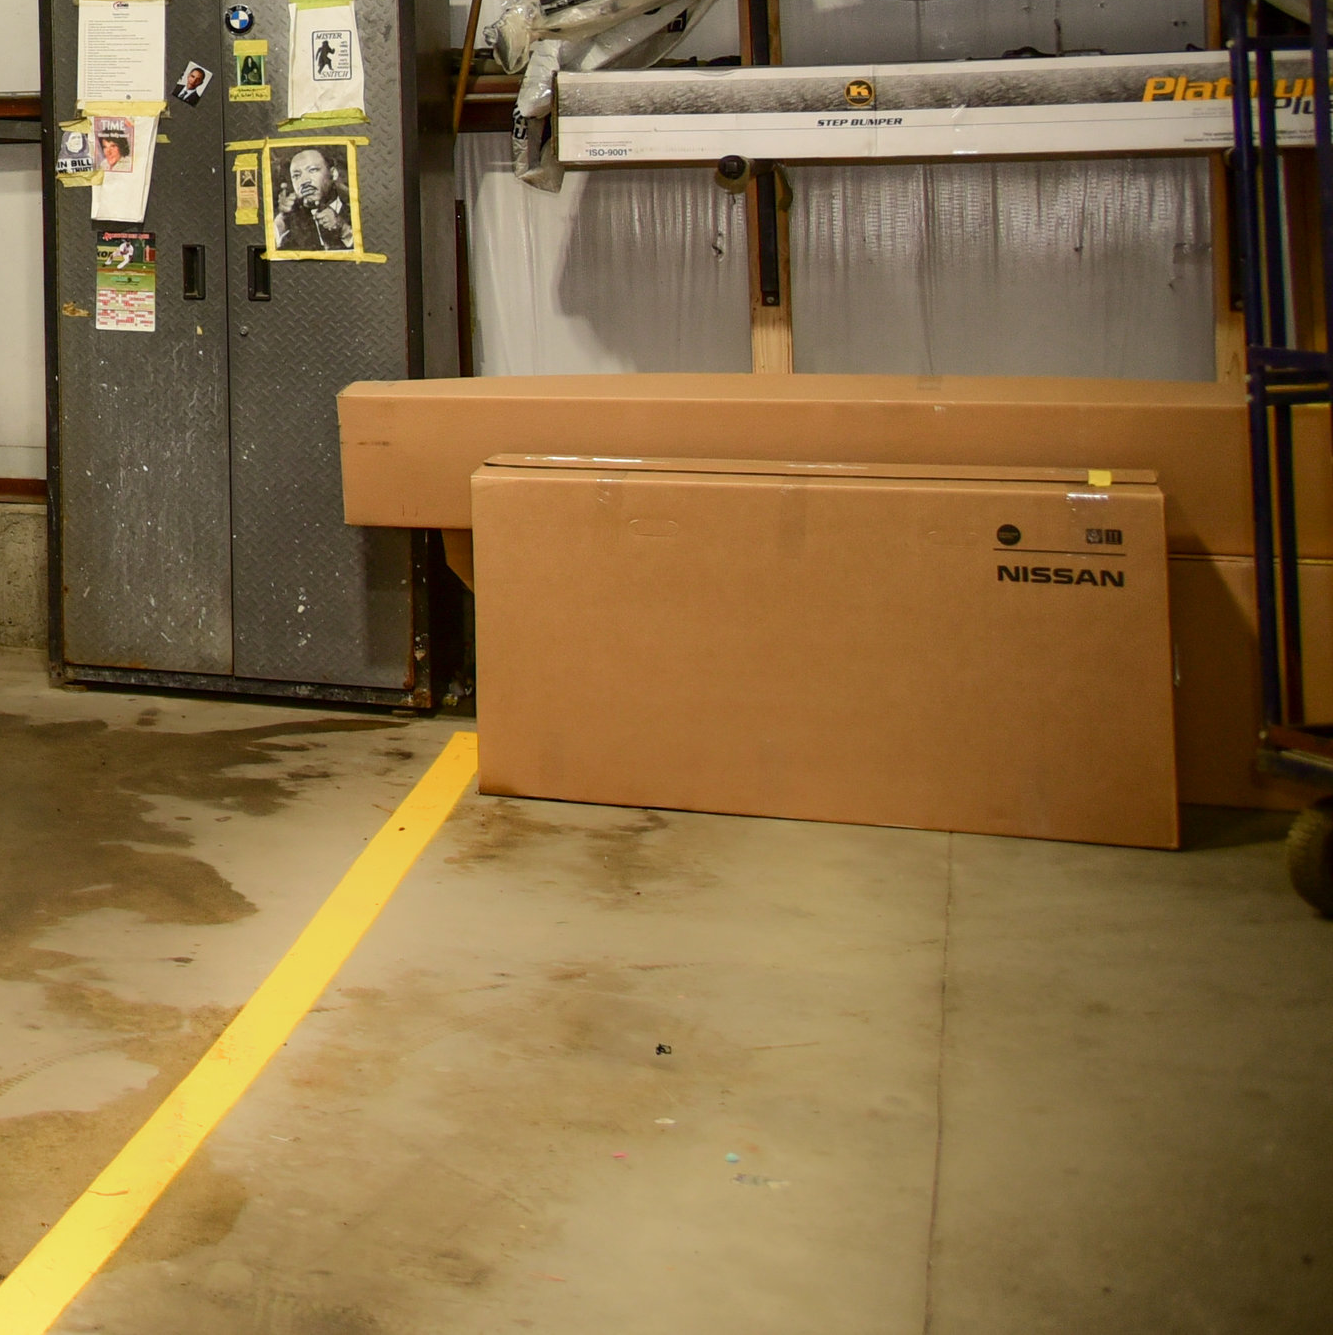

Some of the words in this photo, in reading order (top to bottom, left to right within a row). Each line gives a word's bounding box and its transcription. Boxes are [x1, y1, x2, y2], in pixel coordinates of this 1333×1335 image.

[101, 120, 126, 131] TIME
[817, 118, 848, 127] STEP
[850, 117, 903, 126] BUMPER
[57, 160, 68, 168] IN
[71, 158, 92, 167] BILL
[997, 565, 1125, 588] NISSAN
